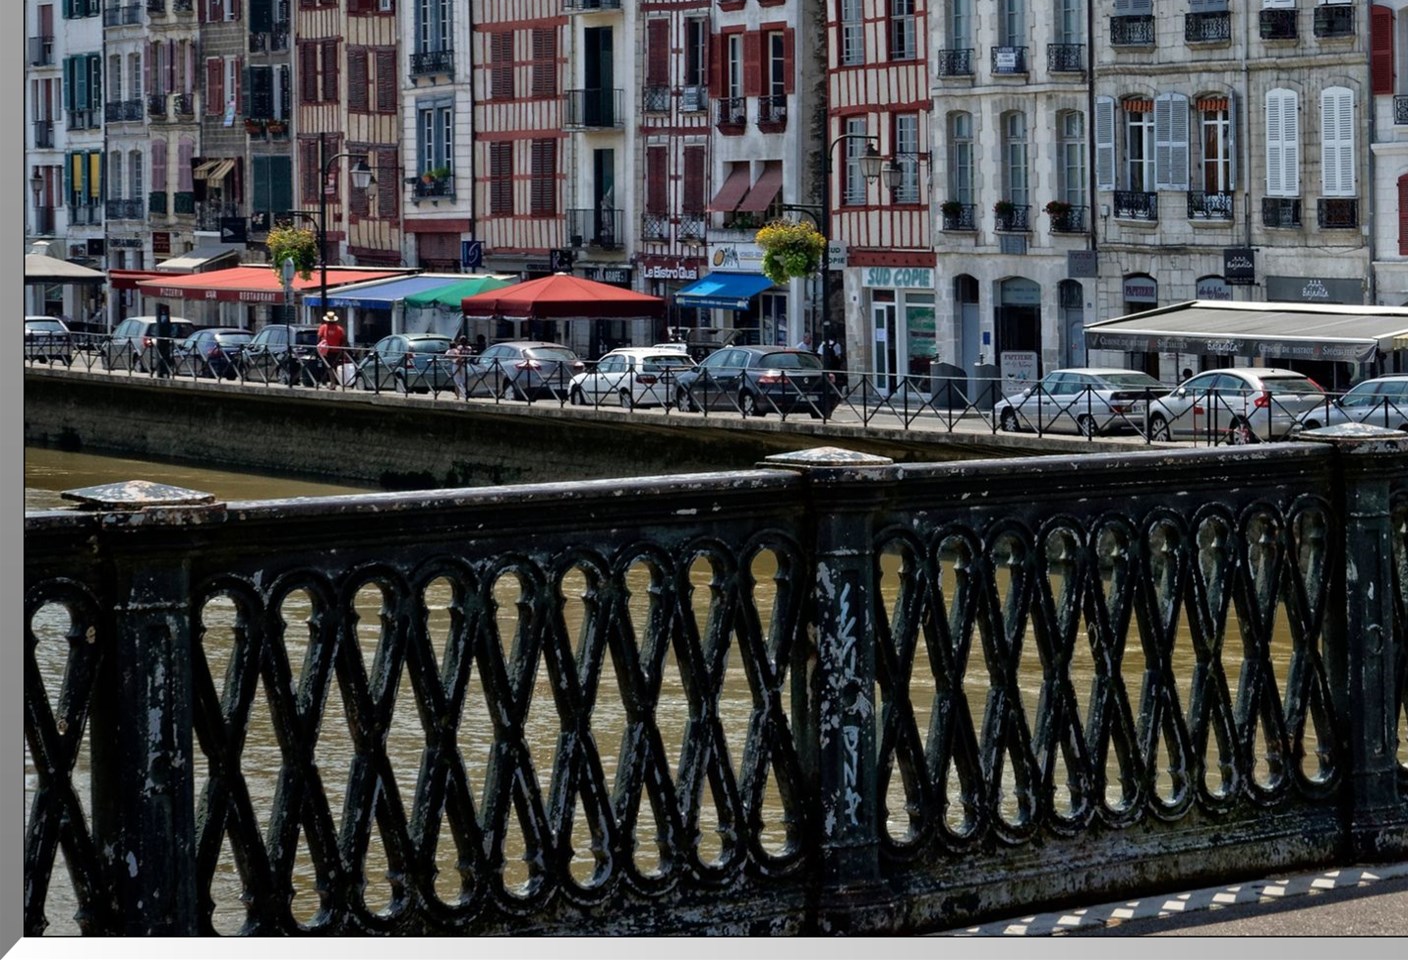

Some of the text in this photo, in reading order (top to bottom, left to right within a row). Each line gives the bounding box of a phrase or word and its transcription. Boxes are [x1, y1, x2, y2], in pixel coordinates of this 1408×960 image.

[643, 266, 653, 278] Le
[868, 268, 930, 287] SUD COPIE
[160, 287, 183, 297] PIZZERIA
[239, 292, 276, 301] RESTAURANT
